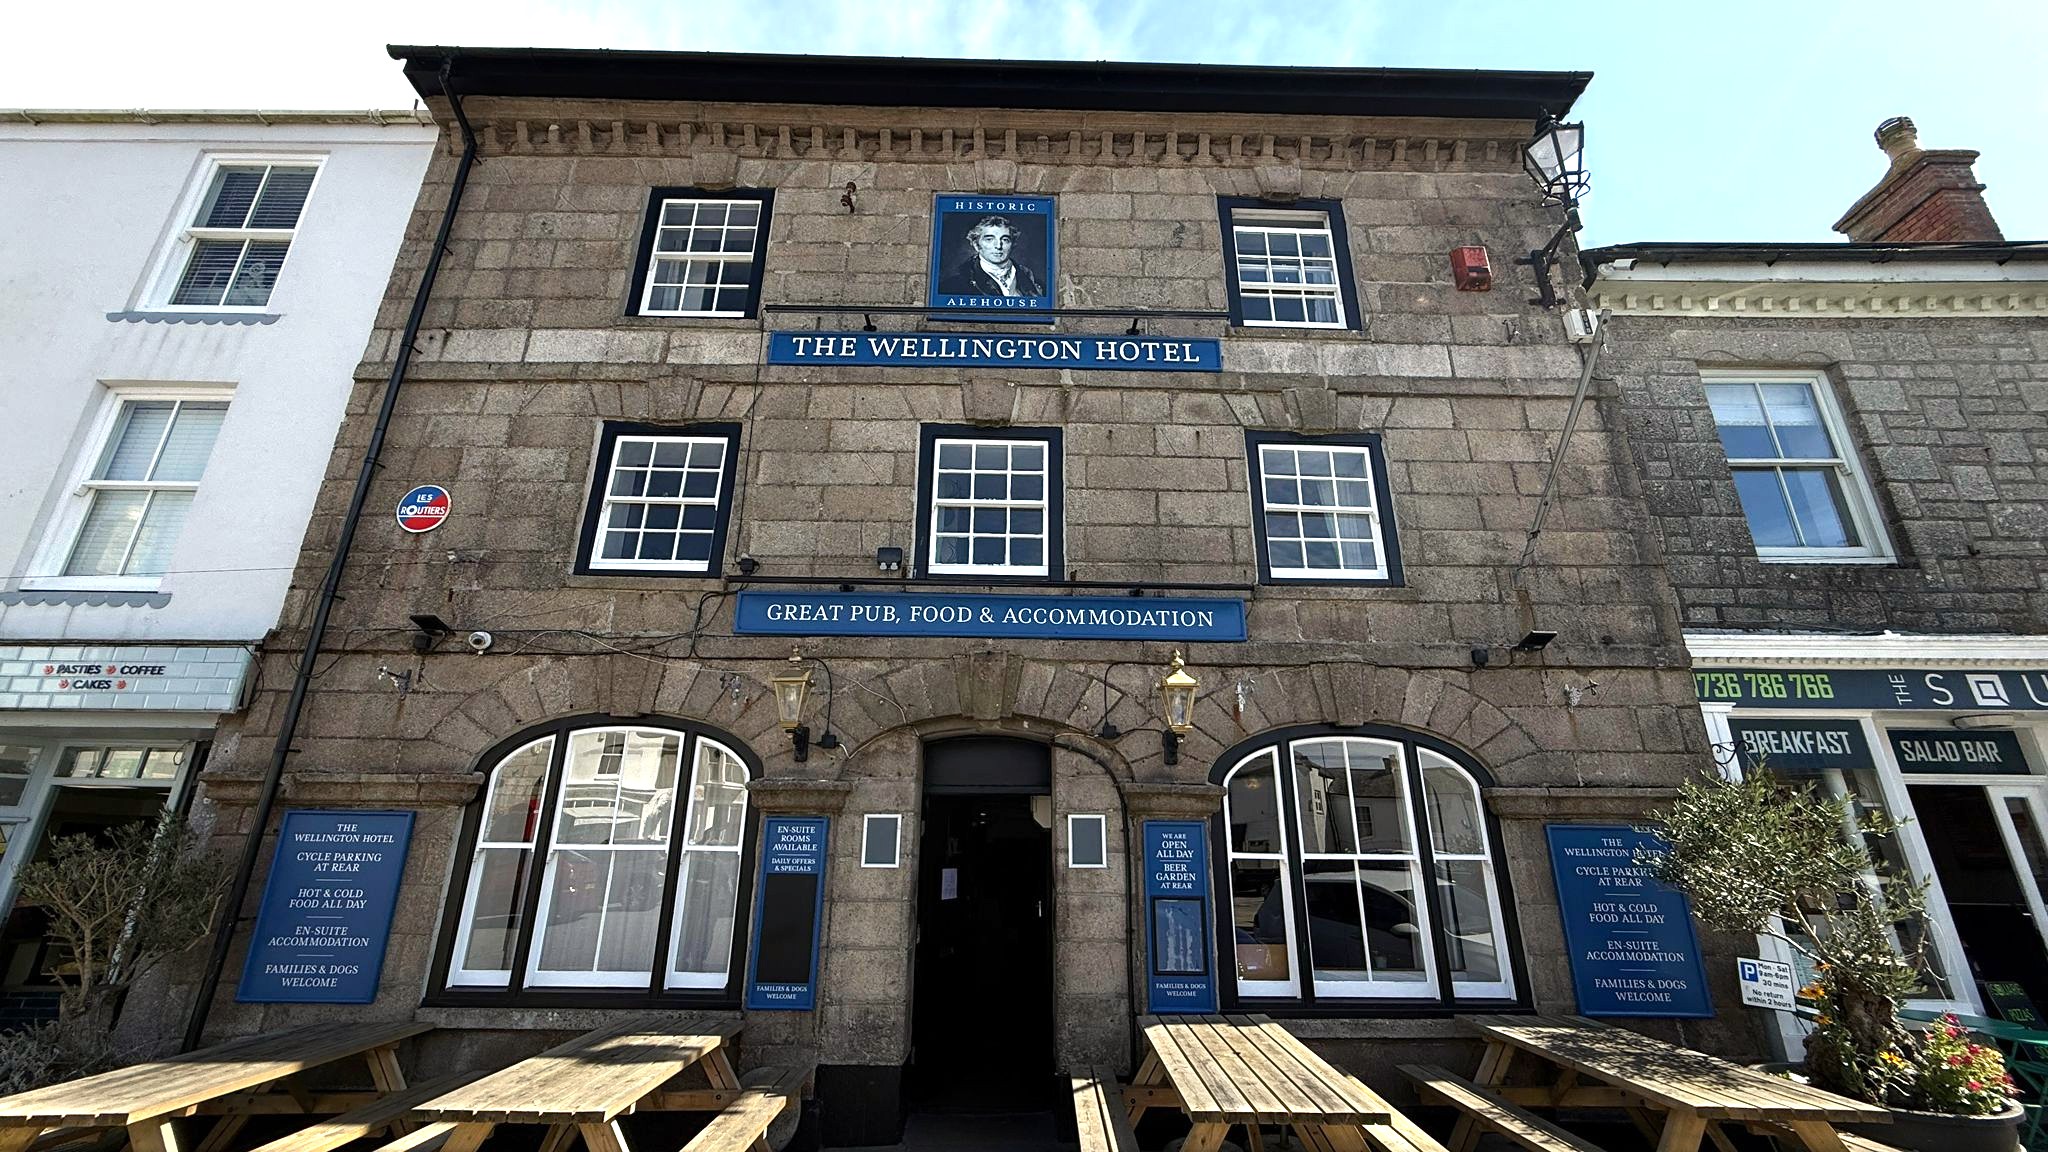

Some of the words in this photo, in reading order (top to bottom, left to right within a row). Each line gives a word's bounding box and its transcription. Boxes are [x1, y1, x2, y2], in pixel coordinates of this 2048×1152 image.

[955, 201, 1035, 211] HISTORIC
[947, 298, 1037, 307] ALEHOUSE
[792, 336, 857, 357] THE
[867, 337, 1082, 360] WELLINGTON
[1095, 341, 1200, 362] HOTEL
[417, 494, 434, 503] LES
[400, 505, 446, 515] ROUTIERS
[767, 604, 844, 622] GREAT
[850, 605, 901, 625] PUB,
[910, 606, 973, 623] FOOD
[979, 607, 995, 623] &
[1001, 607, 1214, 627] ACCOMMODATION
[56, 665, 102, 675] PASTIES
[120, 666, 166, 675] COFFEE
[72, 680, 112, 690] CAKES
[1743, 673, 1787, 698] 786
[1788, 674, 1834, 698] 766
[1888, 673, 1912, 706] THE
[1741, 730, 1852, 754] BREAKFAST
[1900, 740, 1961, 762] SALAD
[1960, 741, 2002, 763] BAR
[337, 824, 357, 832] THE
[295, 833, 360, 842] WELLINGTON
[363, 834, 394, 843] HOTEL
[1601, 838, 1623, 846] THE
[773, 843, 818, 851] AVAILABLE
[1161, 841, 1187, 849] OPEN
[297, 852, 331, 861] CYCLE
[333, 853, 382, 862] PARKING
[1156, 850, 1174, 858] ALL
[1176, 850, 1194, 858] DAY
[1564, 848, 1629, 857] WELLINGTON
[314, 863, 330, 872] AT
[331, 863, 360, 872] REAR
[1164, 863, 1187, 871] BEER
[1576, 867, 1610, 876] CYCLE
[1155, 872, 1196, 881] GARDEN
[1598, 877, 1613, 886] AT
[1615, 878, 1643, 887] REAR
[298, 889, 322, 897] HOT
[323, 889, 331, 897] &
[334, 889, 364, 898] COLD
[289, 900, 319, 908] FOOD
[321, 900, 343, 908] ALL
[345, 900, 368, 908] DAY
[1593, 903, 1617, 912] HOT
[1618, 903, 1627, 912] &
[1629, 903, 1658, 913] COLD
[1589, 913, 1619, 922] FOOD
[1622, 914, 1643, 923] ALL
[1645, 914, 1665, 924] DAY
[295, 926, 349, 935] EN-SUITE
[268, 937, 369, 947] ACCOMMODATION
[1607, 940, 1660, 950] EN-SUITE
[1586, 951, 1685, 962] ACCOMMODATION
[265, 964, 317, 974] FAMILIES
[318, 965, 326, 974] &
[329, 965, 359, 974] DOGS
[1744, 964, 1755, 979] P
[282, 978, 338, 987] WELCOME
[1594, 978, 1646, 989] FAMILIES
[1647, 980, 1656, 989] &
[1658, 979, 1687, 989] DOGS
[1773, 981, 1789, 989] mins
[1615, 992, 1672, 1002] WELCOME
[1763, 991, 1784, 999] return
[1747, 996, 1767, 1004] within
[1774, 1000, 1792, 1008] hours
